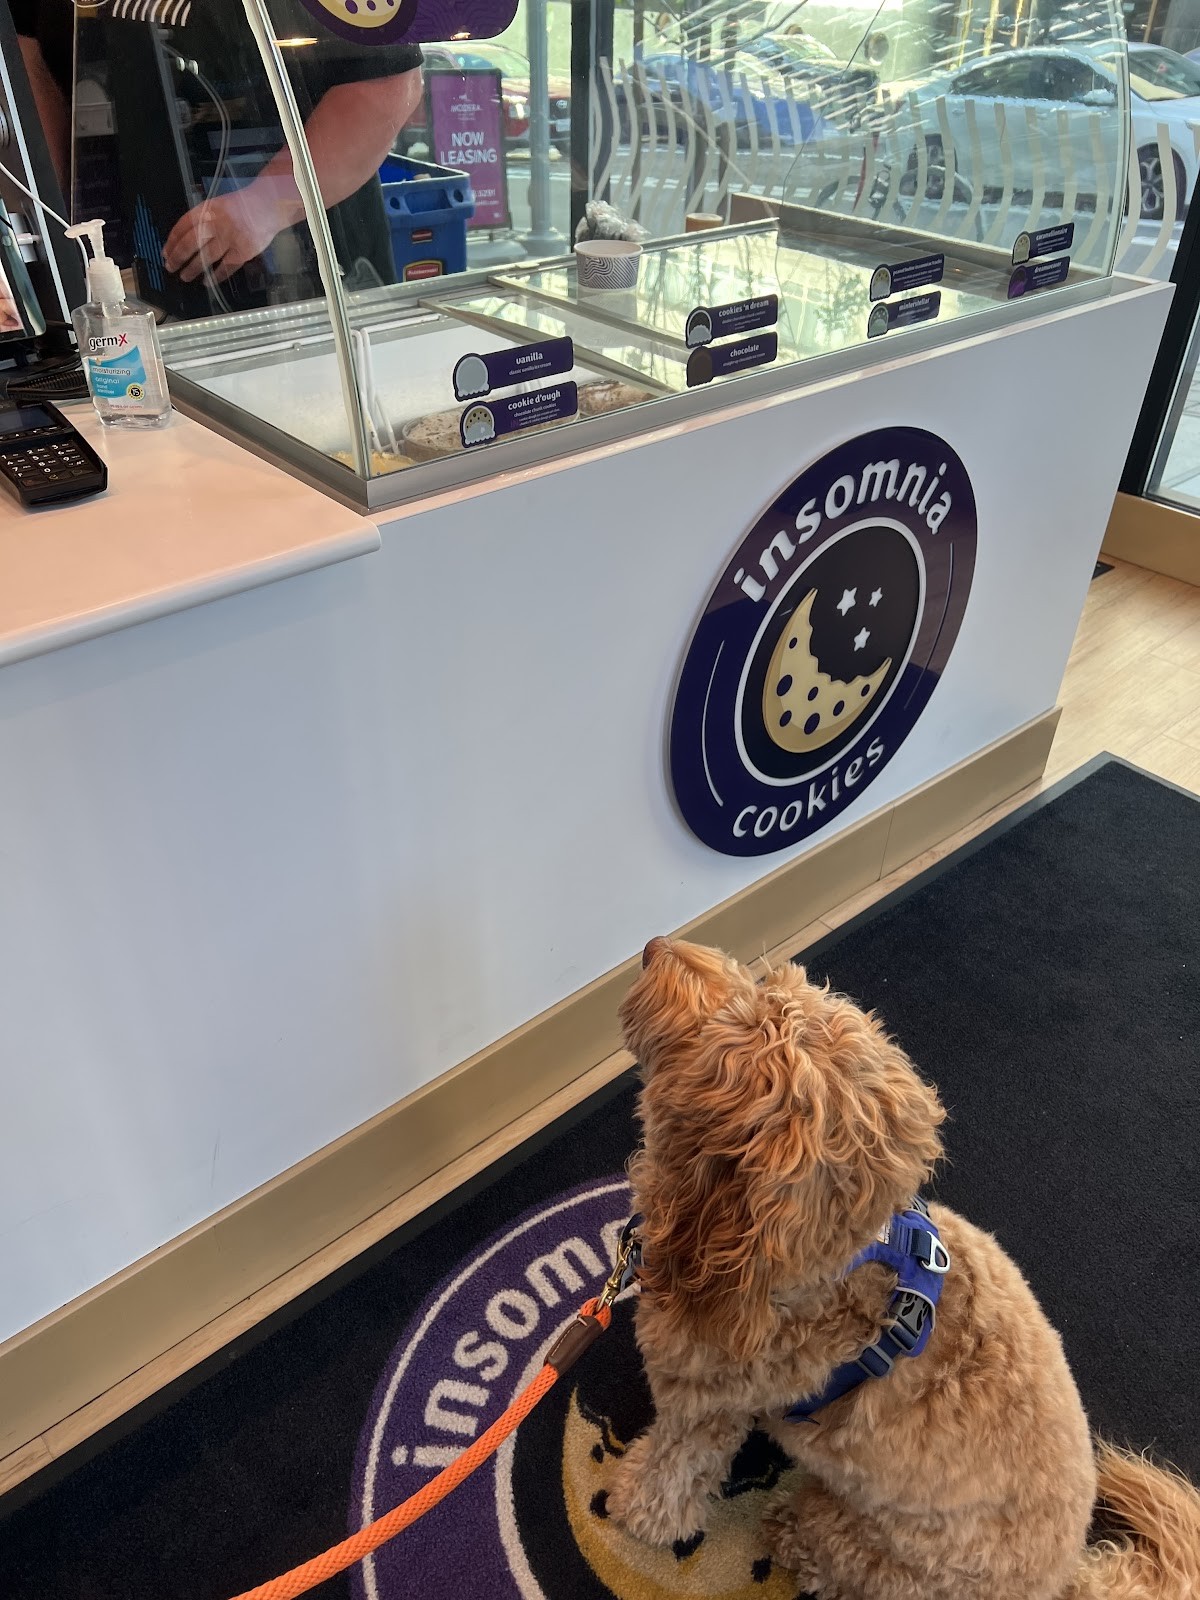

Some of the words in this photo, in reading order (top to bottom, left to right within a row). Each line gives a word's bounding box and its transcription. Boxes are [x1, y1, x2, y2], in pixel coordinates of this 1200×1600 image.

[451, 132, 484, 147] NOW
[440, 148, 498, 166] LEASING
[718, 306, 742, 317] cookies
[750, 299, 769, 310] dream
[89, 333, 128, 351] germ-X
[729, 344, 760, 358] chocolate
[515, 351, 544, 365] vanilla
[92, 367, 131, 376] moisturizing
[508, 396, 534, 411] cookie
[535, 389, 561, 402] d'ough
[733, 458, 953, 603] insomnia
[732, 736, 886, 839] cookies
